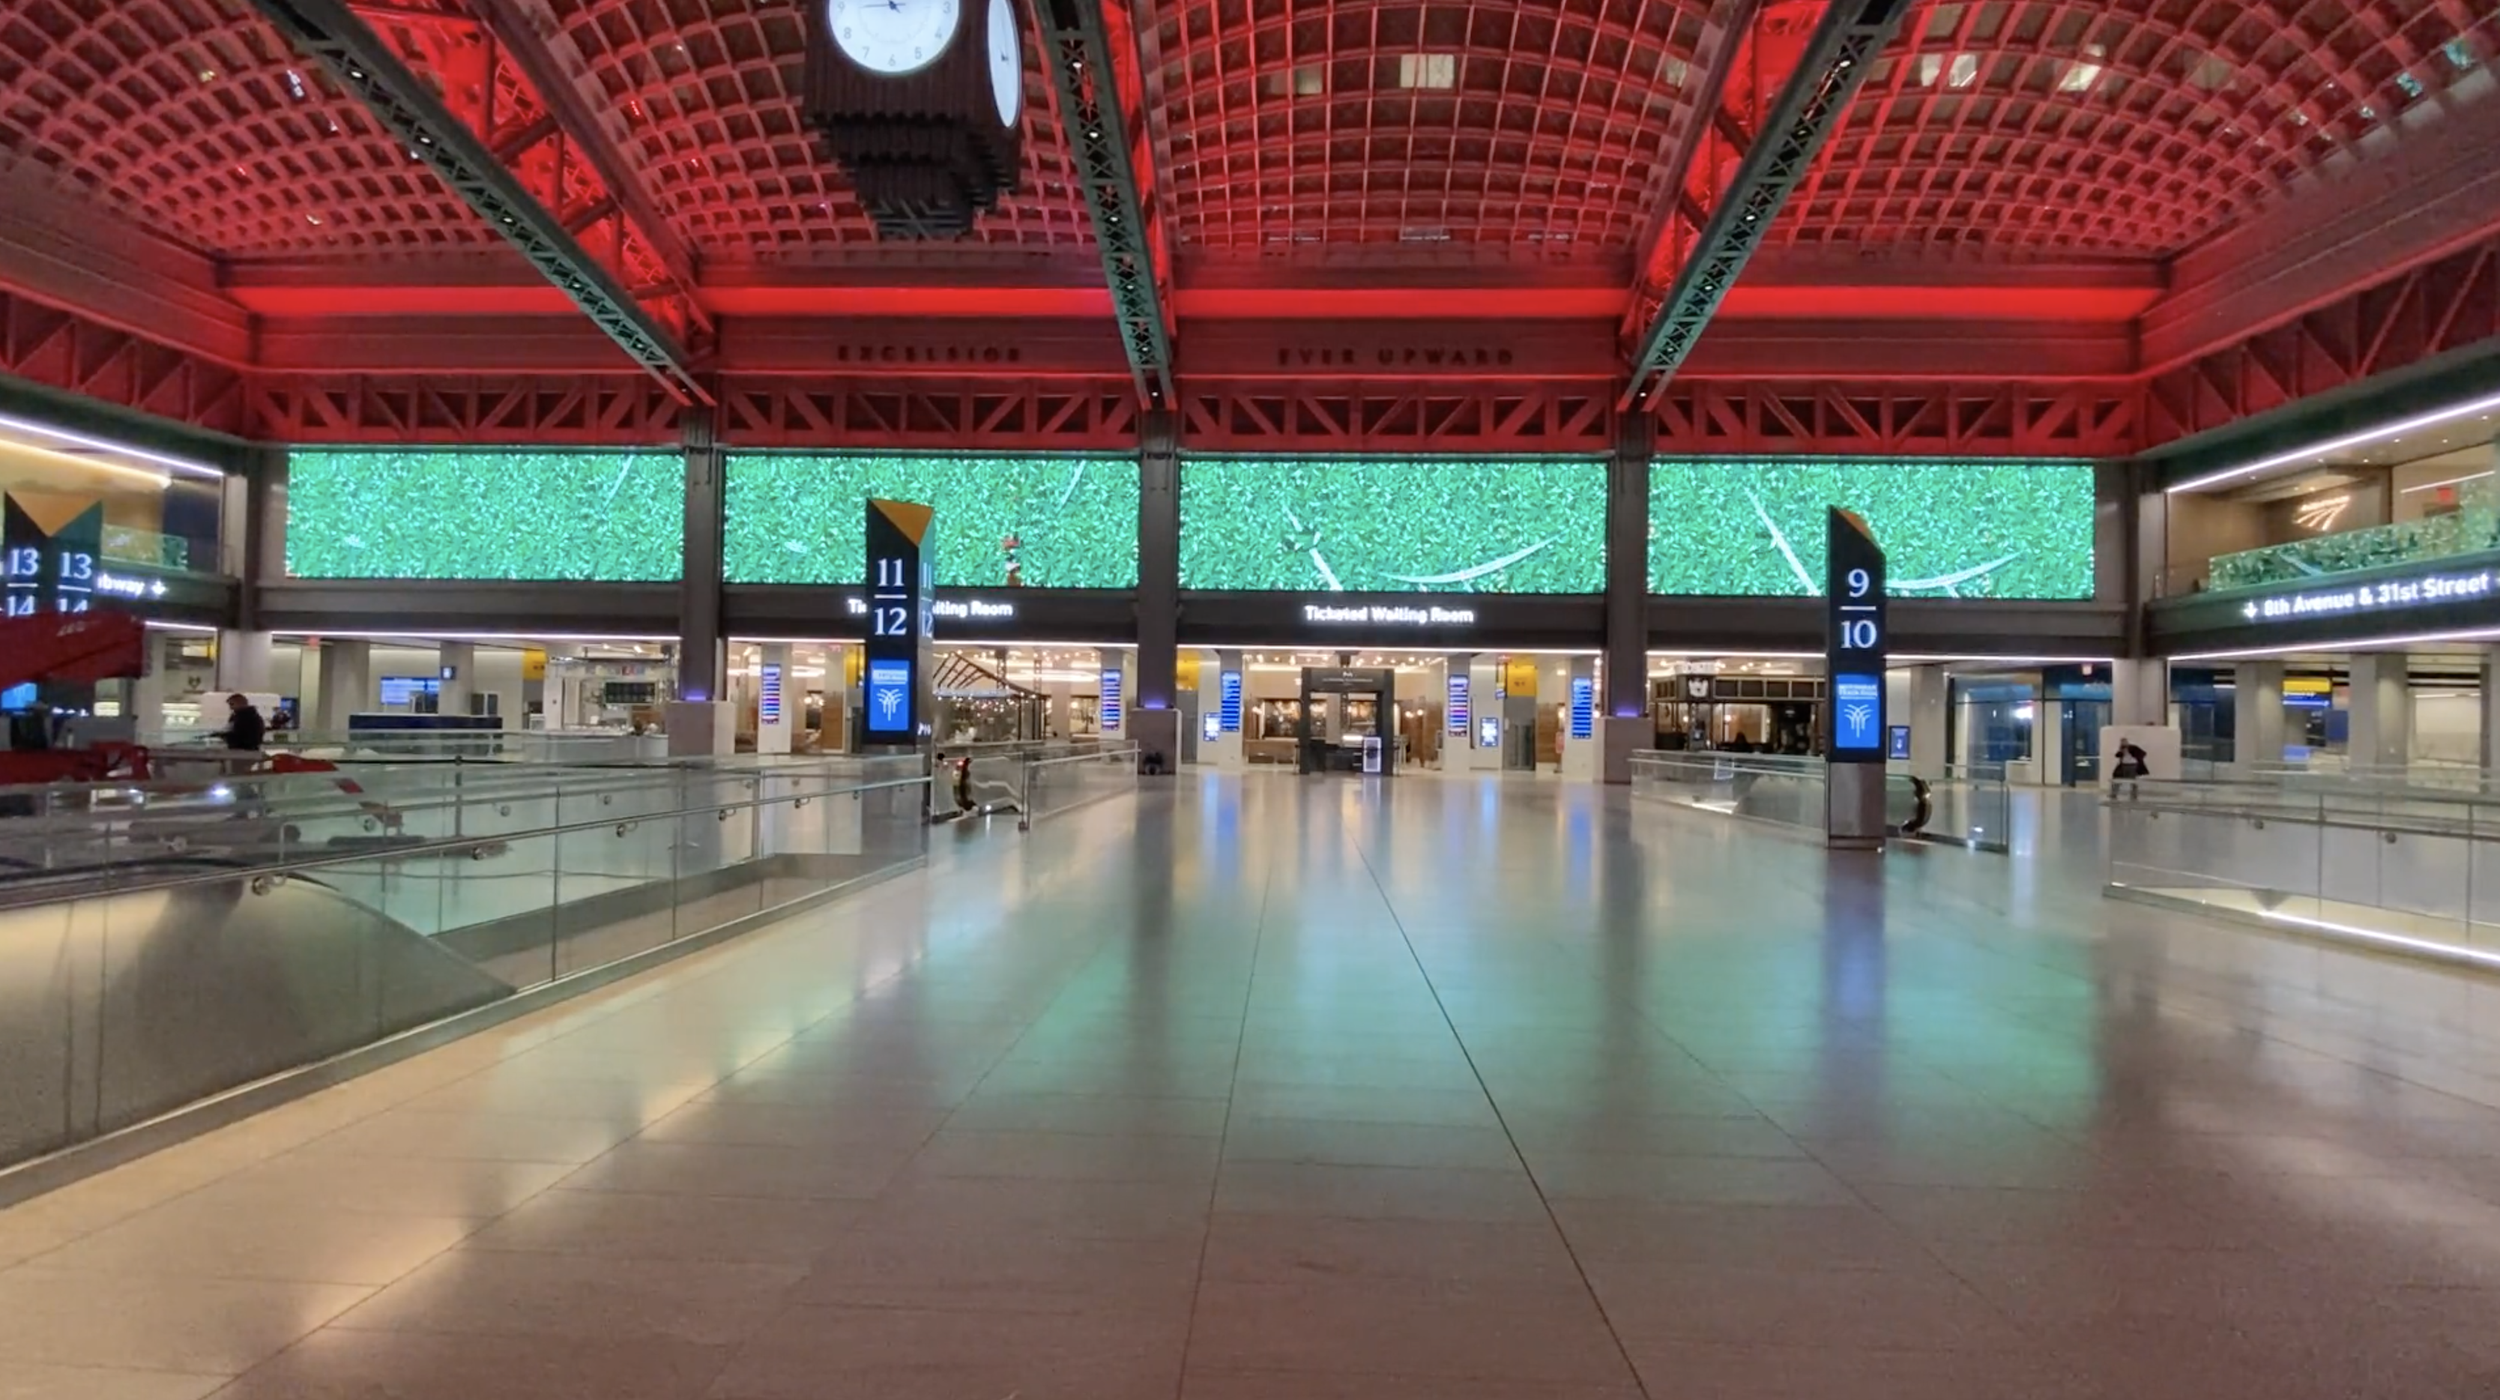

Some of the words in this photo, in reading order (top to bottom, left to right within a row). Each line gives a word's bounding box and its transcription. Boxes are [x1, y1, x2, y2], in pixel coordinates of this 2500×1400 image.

[838, 346, 1020, 362] EXCELSIOR
[1378, 349, 1512, 366] UPWARD
[11, 548, 39, 576] 13
[60, 551, 92, 580] 13
[877, 558, 905, 587] 11
[1848, 568, 1870, 598] 9
[2264, 599, 2289, 616] 8th
[2293, 592, 2354, 614] Avenue
[2359, 587, 2373, 604] &
[2378, 583, 2418, 603] 31st
[2423, 572, 2489, 598] Street
[874, 607, 908, 636] 12
[970, 601, 1014, 616] Room
[1304, 605, 1368, 621] Ticketed
[1371, 606, 1428, 624] Waiting
[1430, 606, 1474, 622] Room
[1840, 620, 1878, 649] 10
